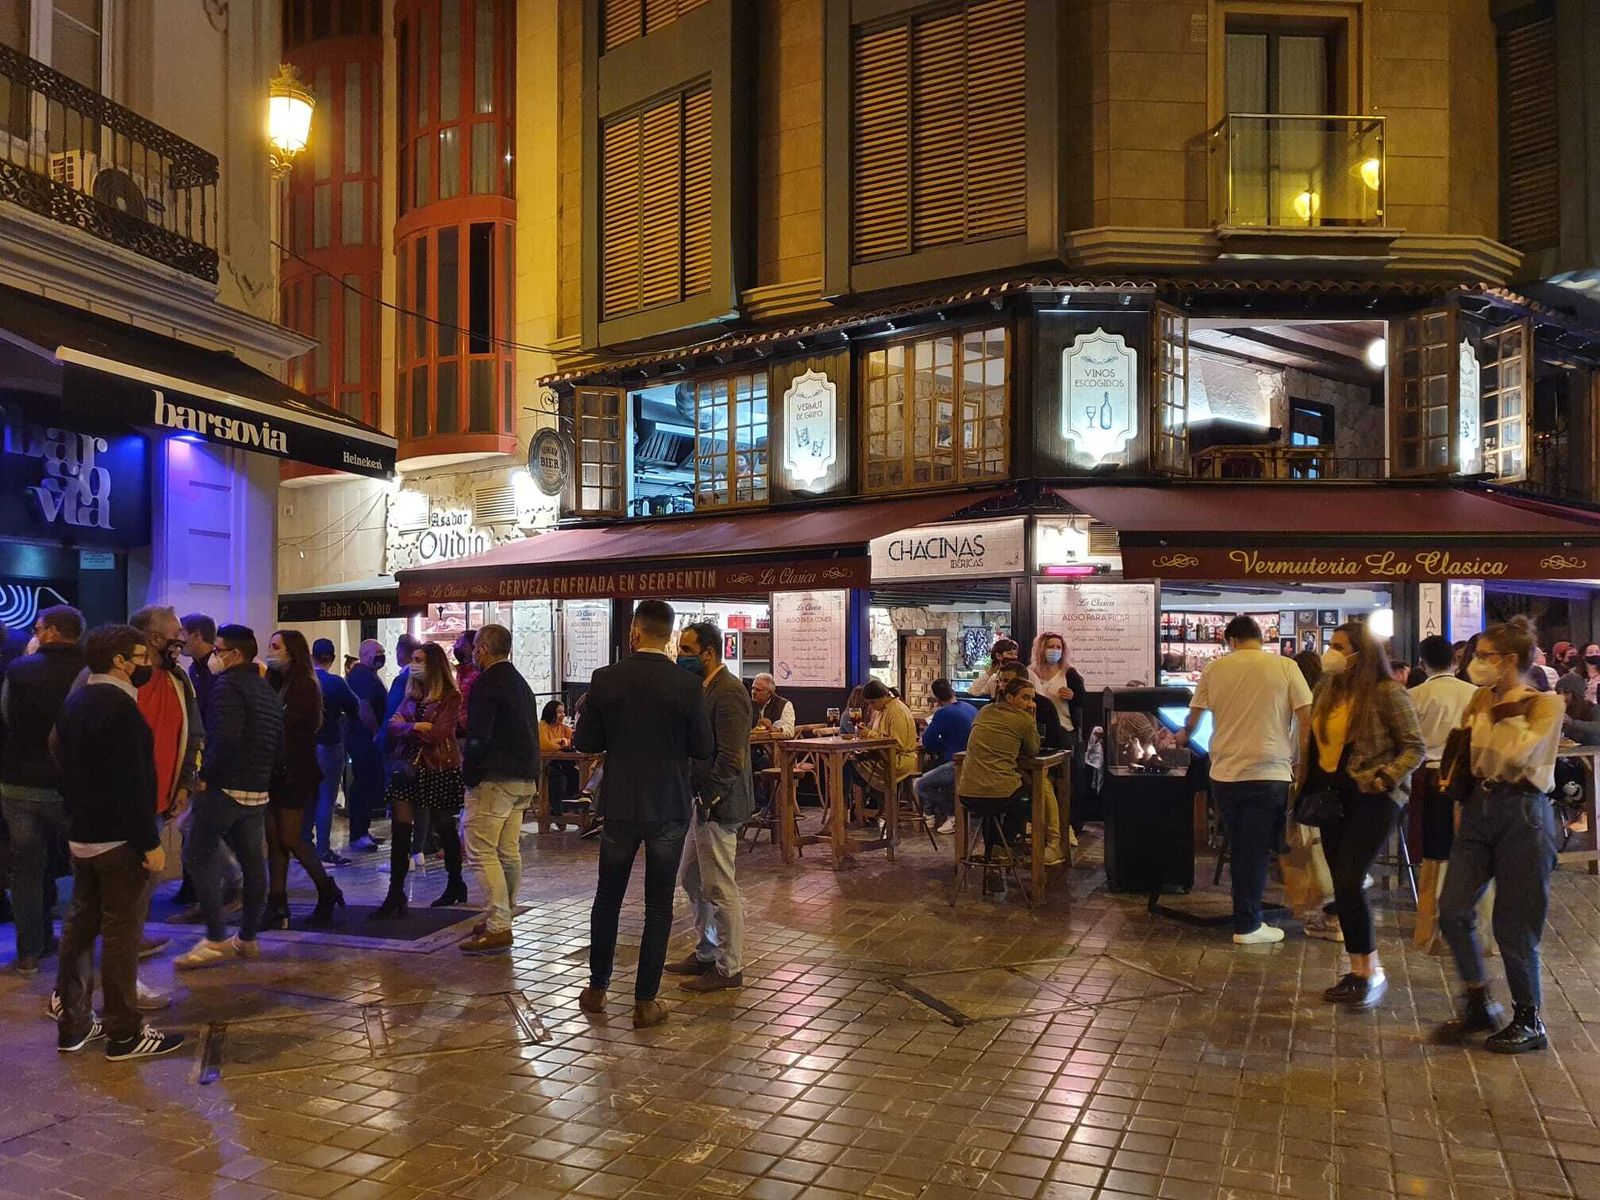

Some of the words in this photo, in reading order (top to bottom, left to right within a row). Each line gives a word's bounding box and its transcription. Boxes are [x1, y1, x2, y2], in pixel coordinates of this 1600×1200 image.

[1083, 368, 1116, 378] VINOS
[1074, 379, 1125, 388] ESCOGIDOS
[796, 400, 823, 411] VERMUT
[152, 389, 289, 454] barsovia
[342, 450, 384, 470] Heineken
[539, 456, 560, 469] BIER
[431, 511, 468, 527] Asador
[419, 527, 484, 560] Ovidio
[888, 534, 986, 561] CHACINAS
[1229, 550, 1363, 575] Vermuteria
[1365, 551, 1412, 575] La
[1415, 551, 1509, 575] Clasica
[498, 578, 550, 597] CERVEZA
[553, 575, 616, 594] ENFRIADA
[619, 574, 635, 592] EN
[639, 569, 717, 592] SERPENTIN
[758, 568, 777, 586] La
[779, 566, 818, 585] Clasica
[320, 600, 352, 617] Asador
[359, 600, 392, 617] Ovidio
[1062, 613, 1086, 621] ALGO
[1086, 613, 1107, 621] PARA
